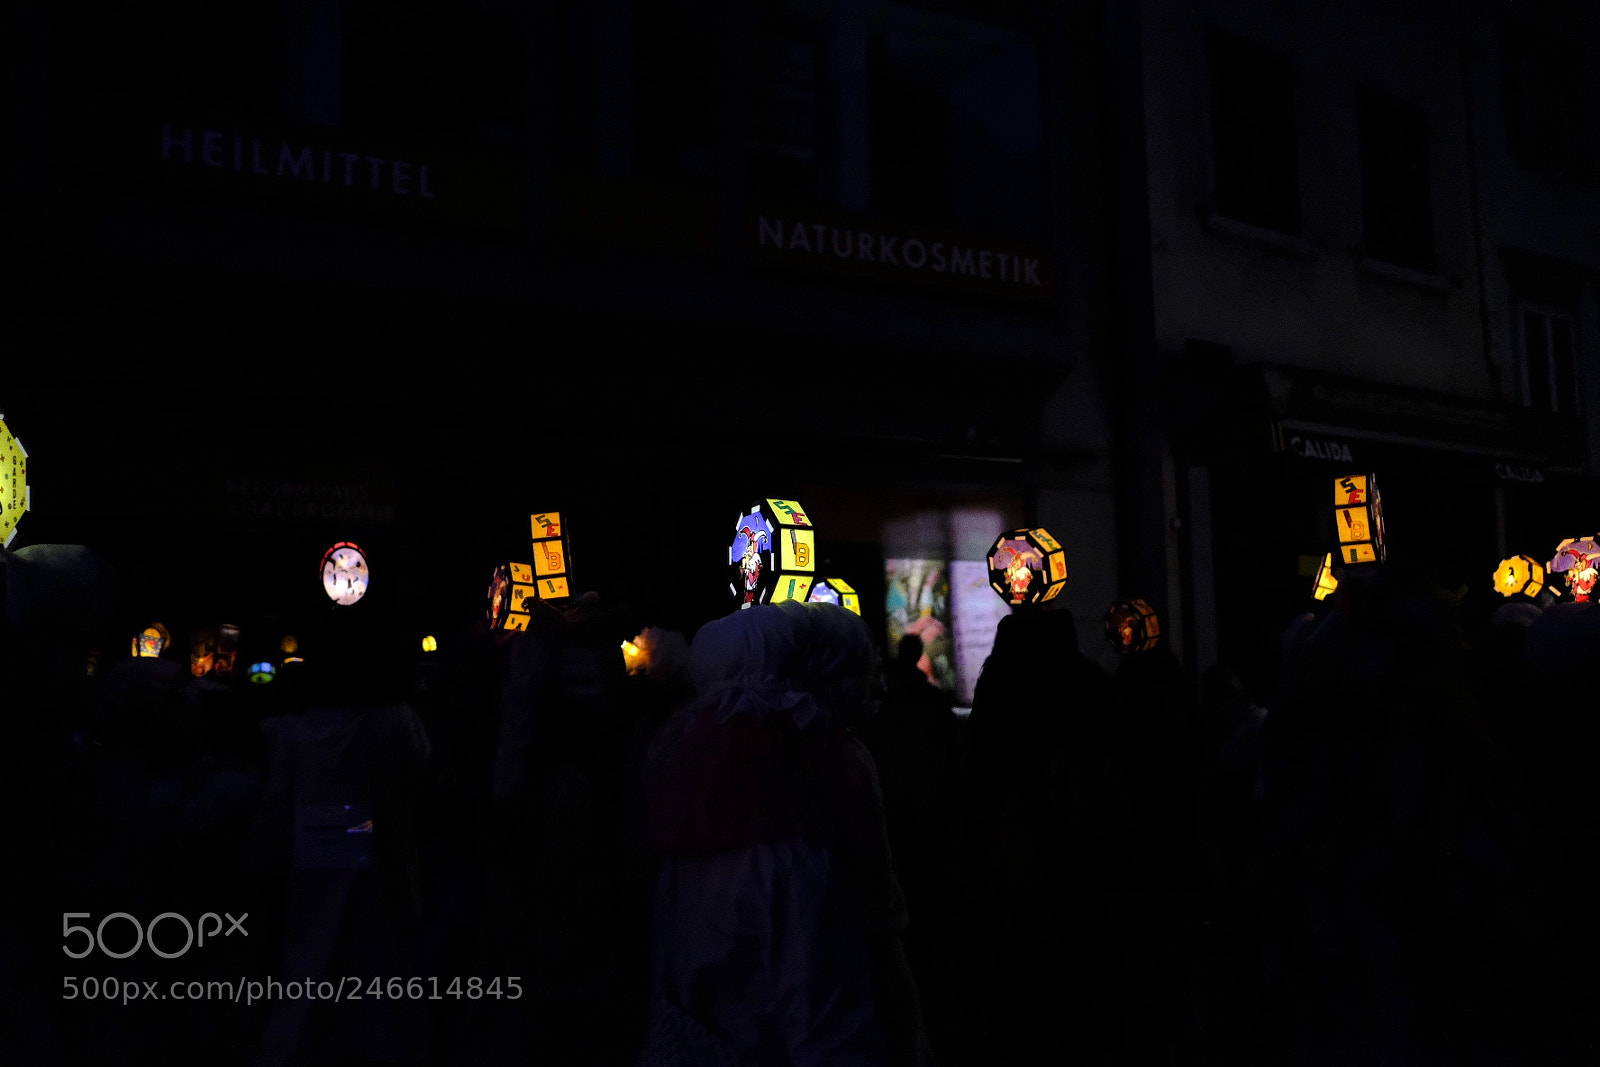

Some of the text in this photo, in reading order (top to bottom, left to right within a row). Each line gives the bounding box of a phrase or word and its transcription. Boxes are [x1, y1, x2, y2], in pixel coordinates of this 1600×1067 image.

[160, 123, 436, 199] HEILMITTEL
[757, 214, 1042, 286] NATURKOSMETIK
[1290, 436, 1353, 463] CALIDA
